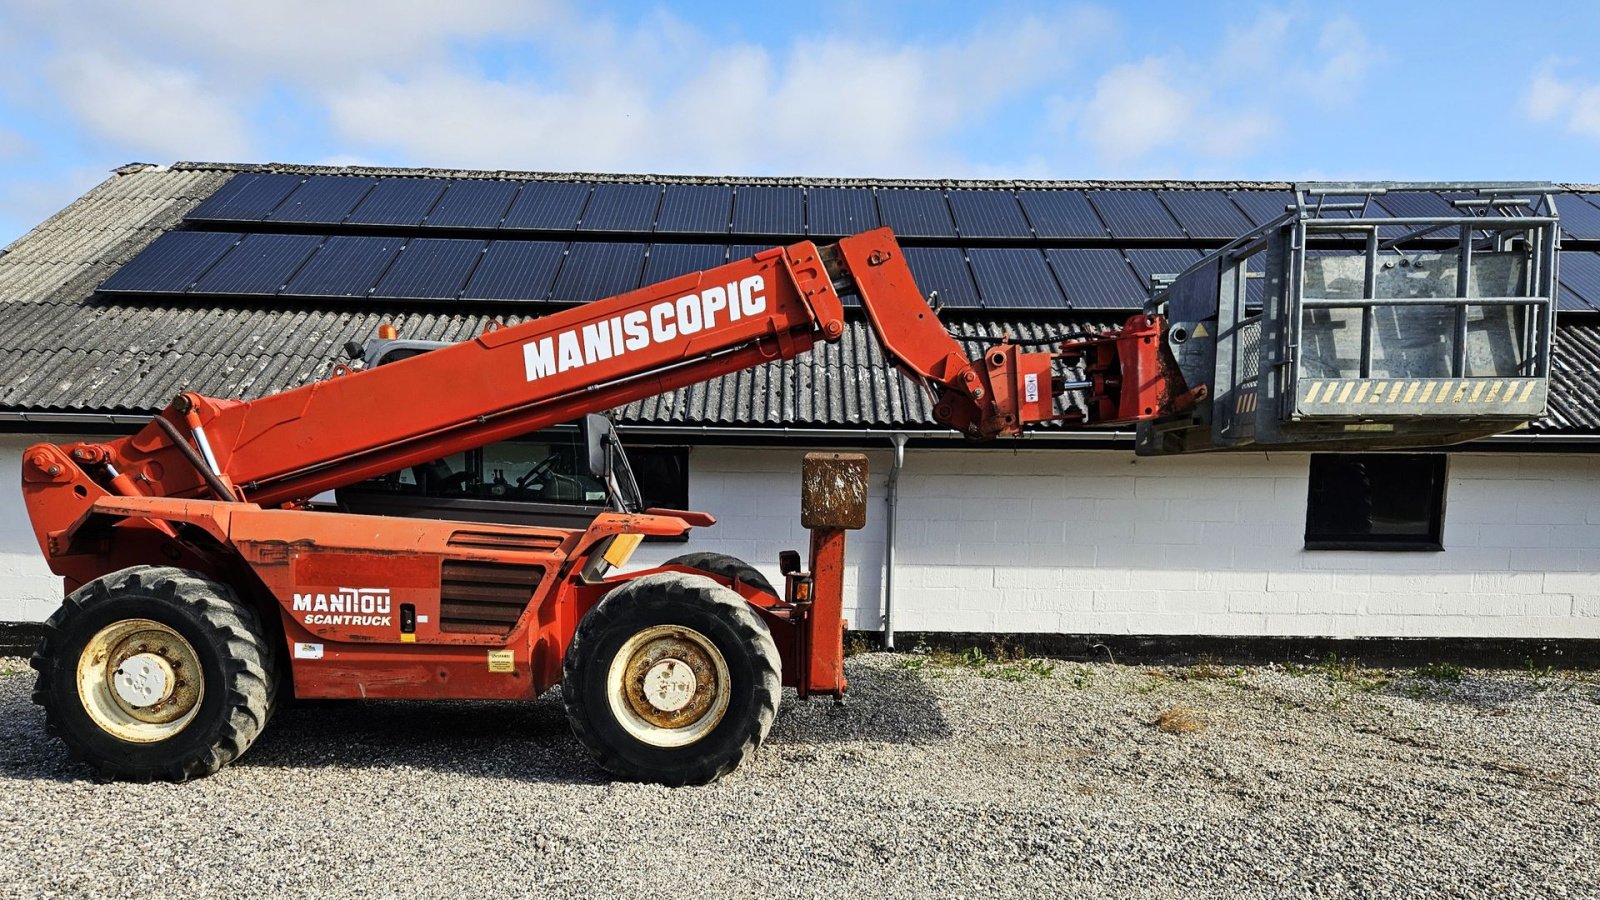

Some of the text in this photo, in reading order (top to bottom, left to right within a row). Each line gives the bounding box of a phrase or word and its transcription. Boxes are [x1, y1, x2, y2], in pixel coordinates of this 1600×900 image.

[523, 275, 766, 382] MANISCOPIC
[293, 587, 390, 614] MANITOU
[304, 615, 391, 626] SCANTRUCK
